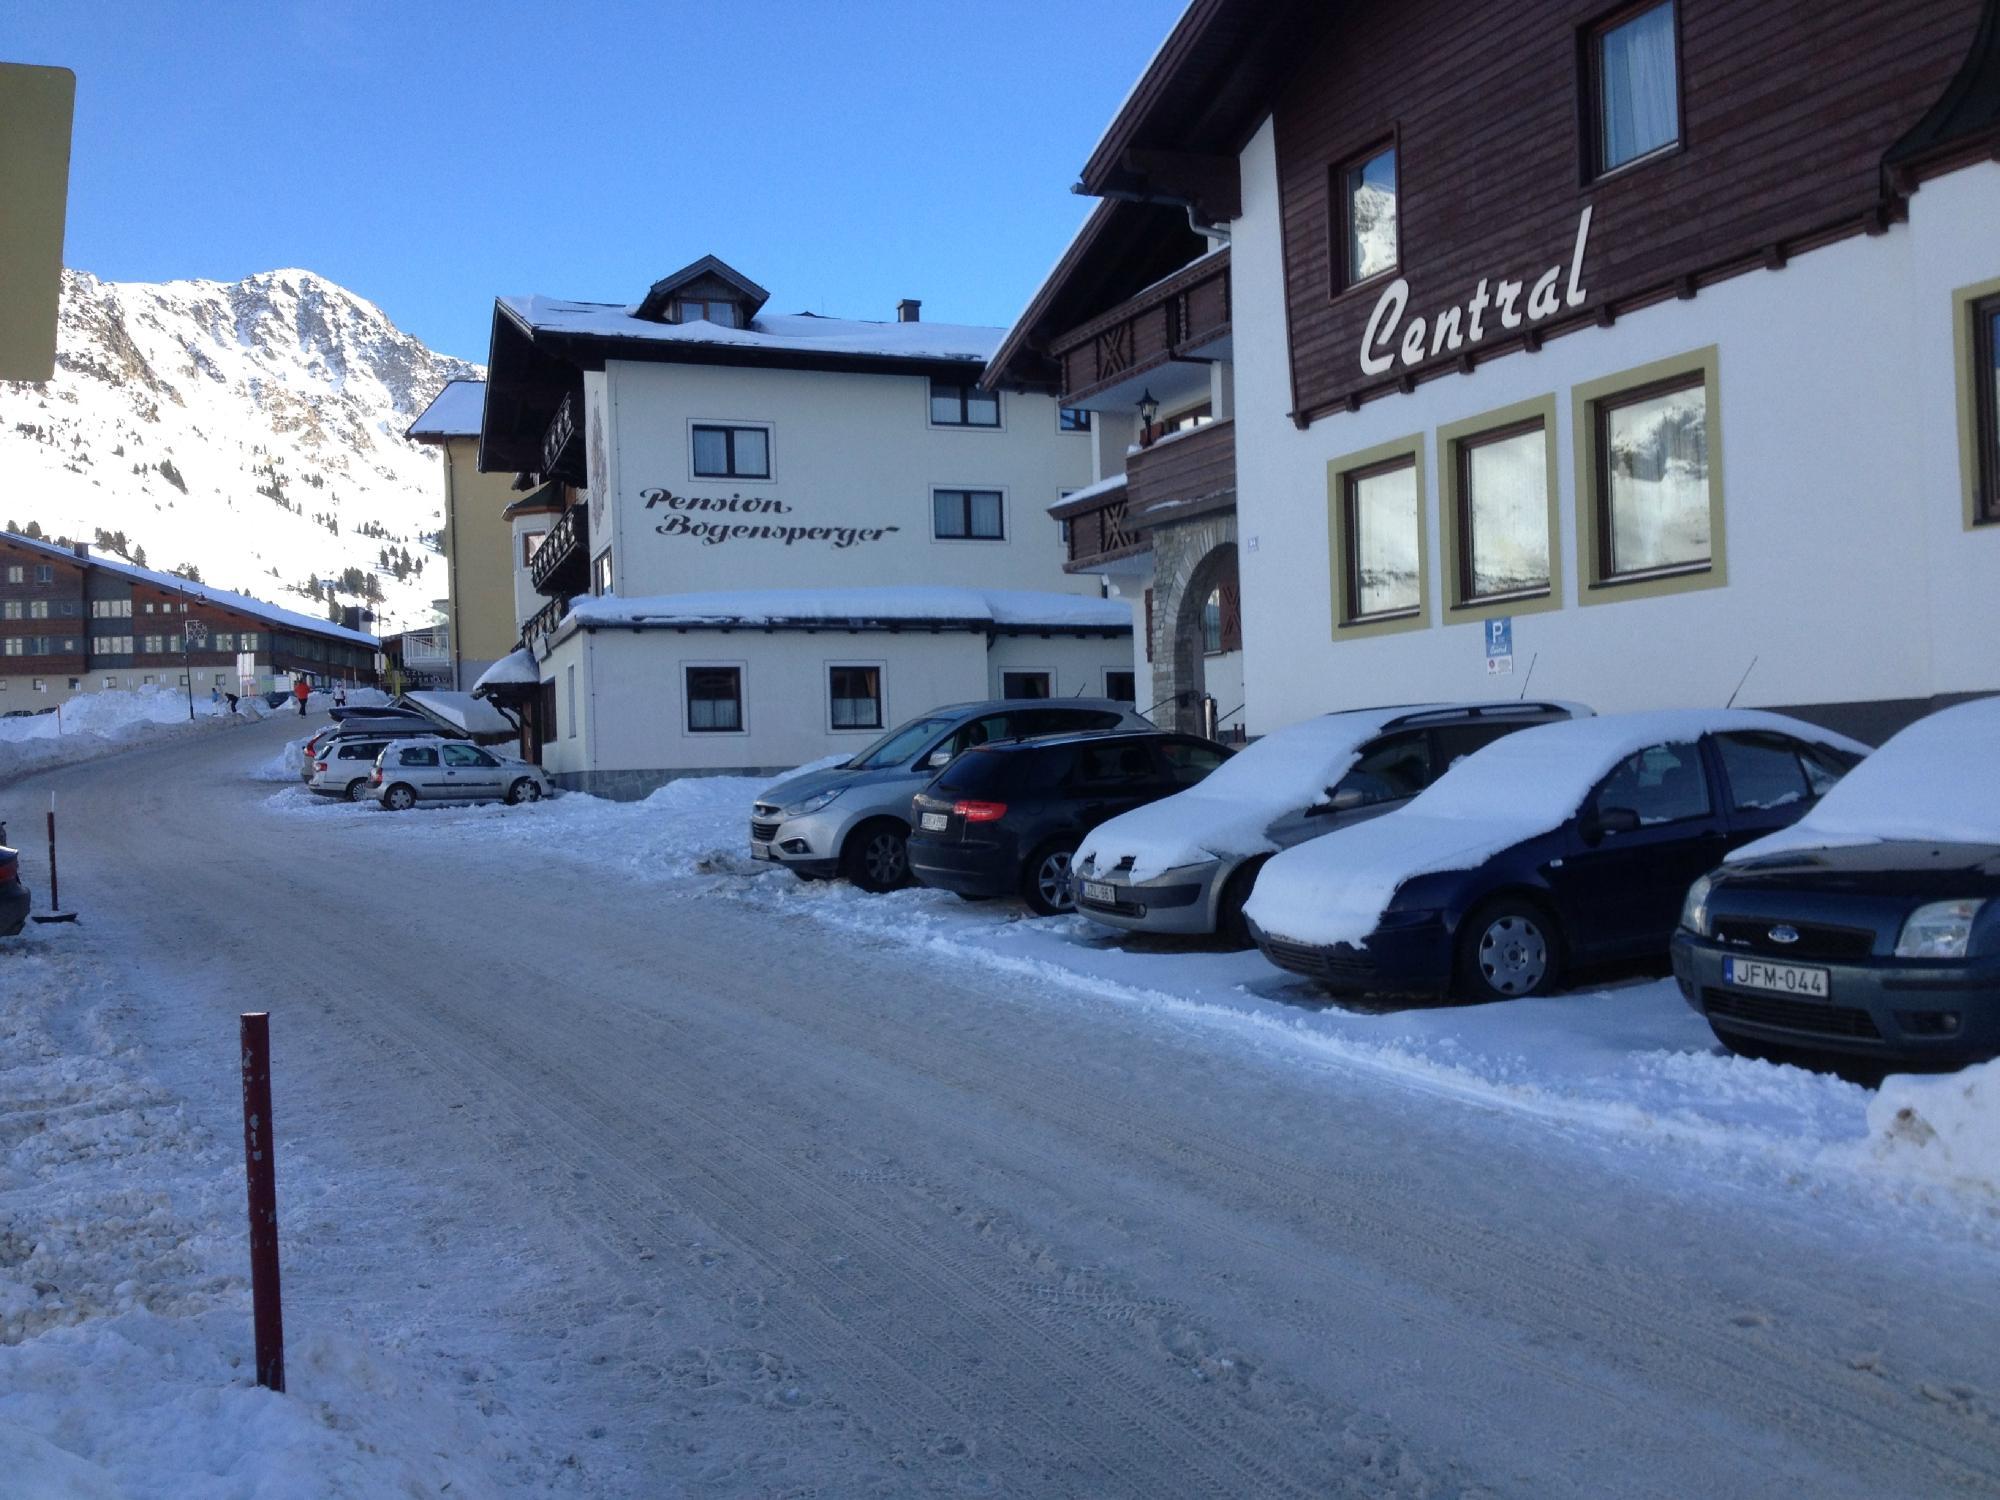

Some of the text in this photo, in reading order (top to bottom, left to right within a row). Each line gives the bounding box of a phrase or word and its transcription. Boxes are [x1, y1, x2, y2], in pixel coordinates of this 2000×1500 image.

[1360, 204, 1593, 376] Central
[640, 488, 792, 514] Pension
[655, 513, 900, 549] Bogensperger
[1492, 621, 1503, 644] P
[1737, 963, 1822, 992] JFM-044
